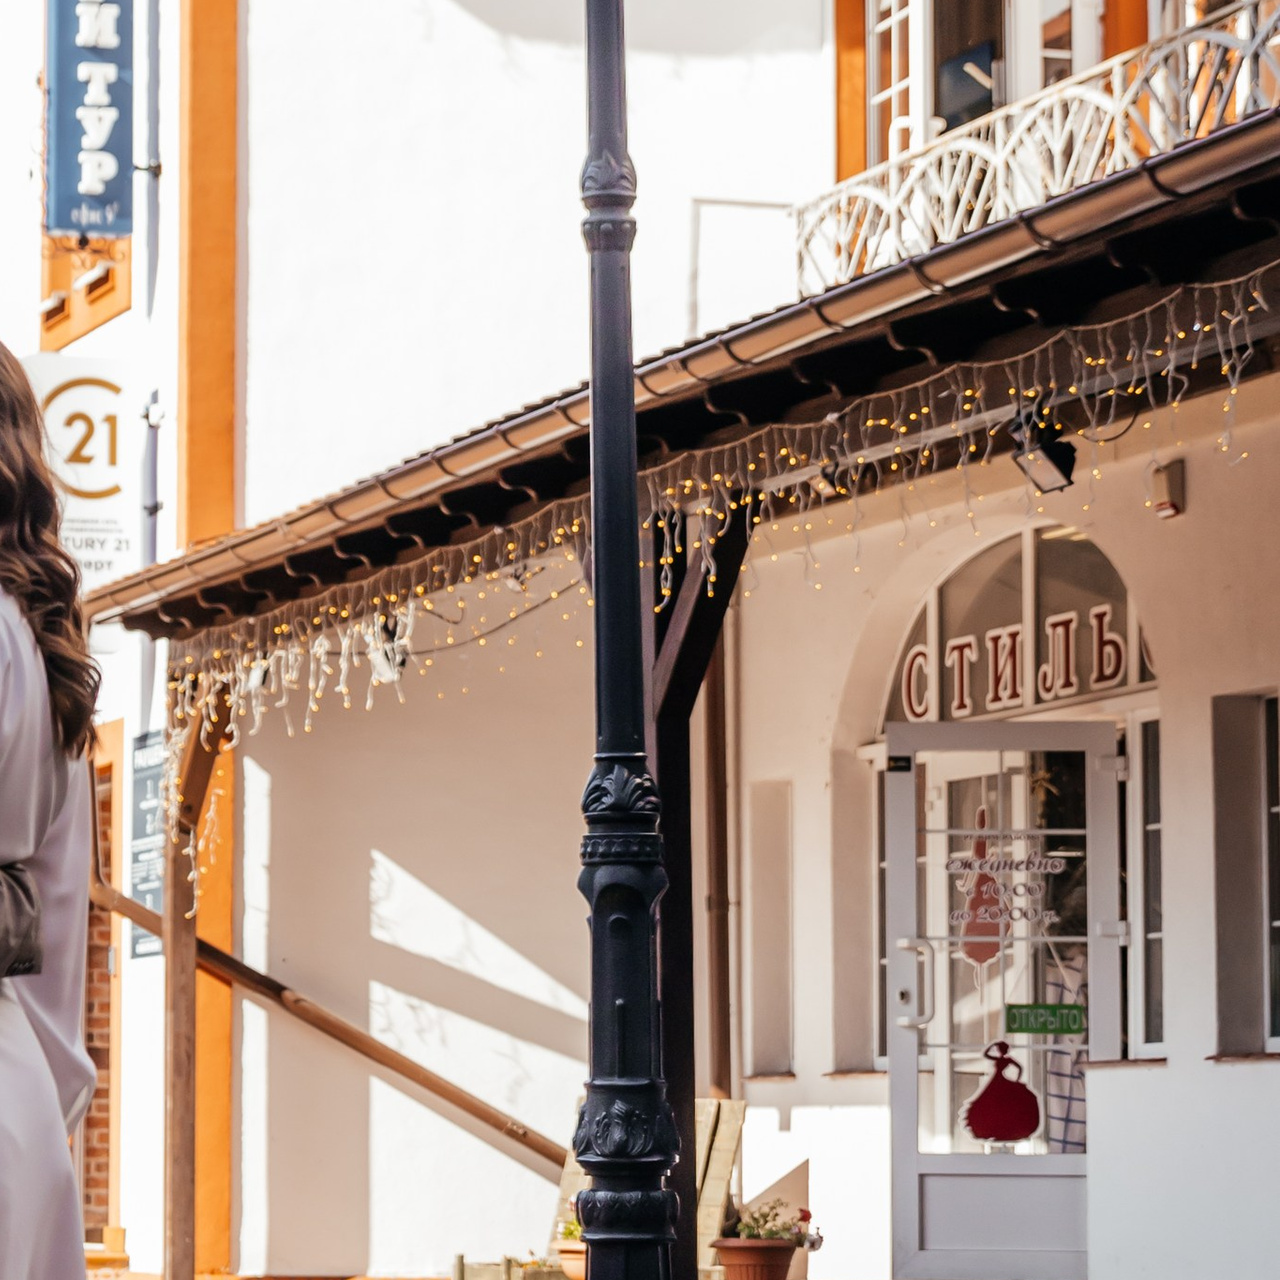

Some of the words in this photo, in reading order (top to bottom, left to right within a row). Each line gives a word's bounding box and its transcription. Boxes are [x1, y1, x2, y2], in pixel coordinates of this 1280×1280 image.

[63, 411, 118, 466] 21
[64, 536, 107, 551] TURY
[1009, 1008, 1080, 1030] ОТКРЫТО
